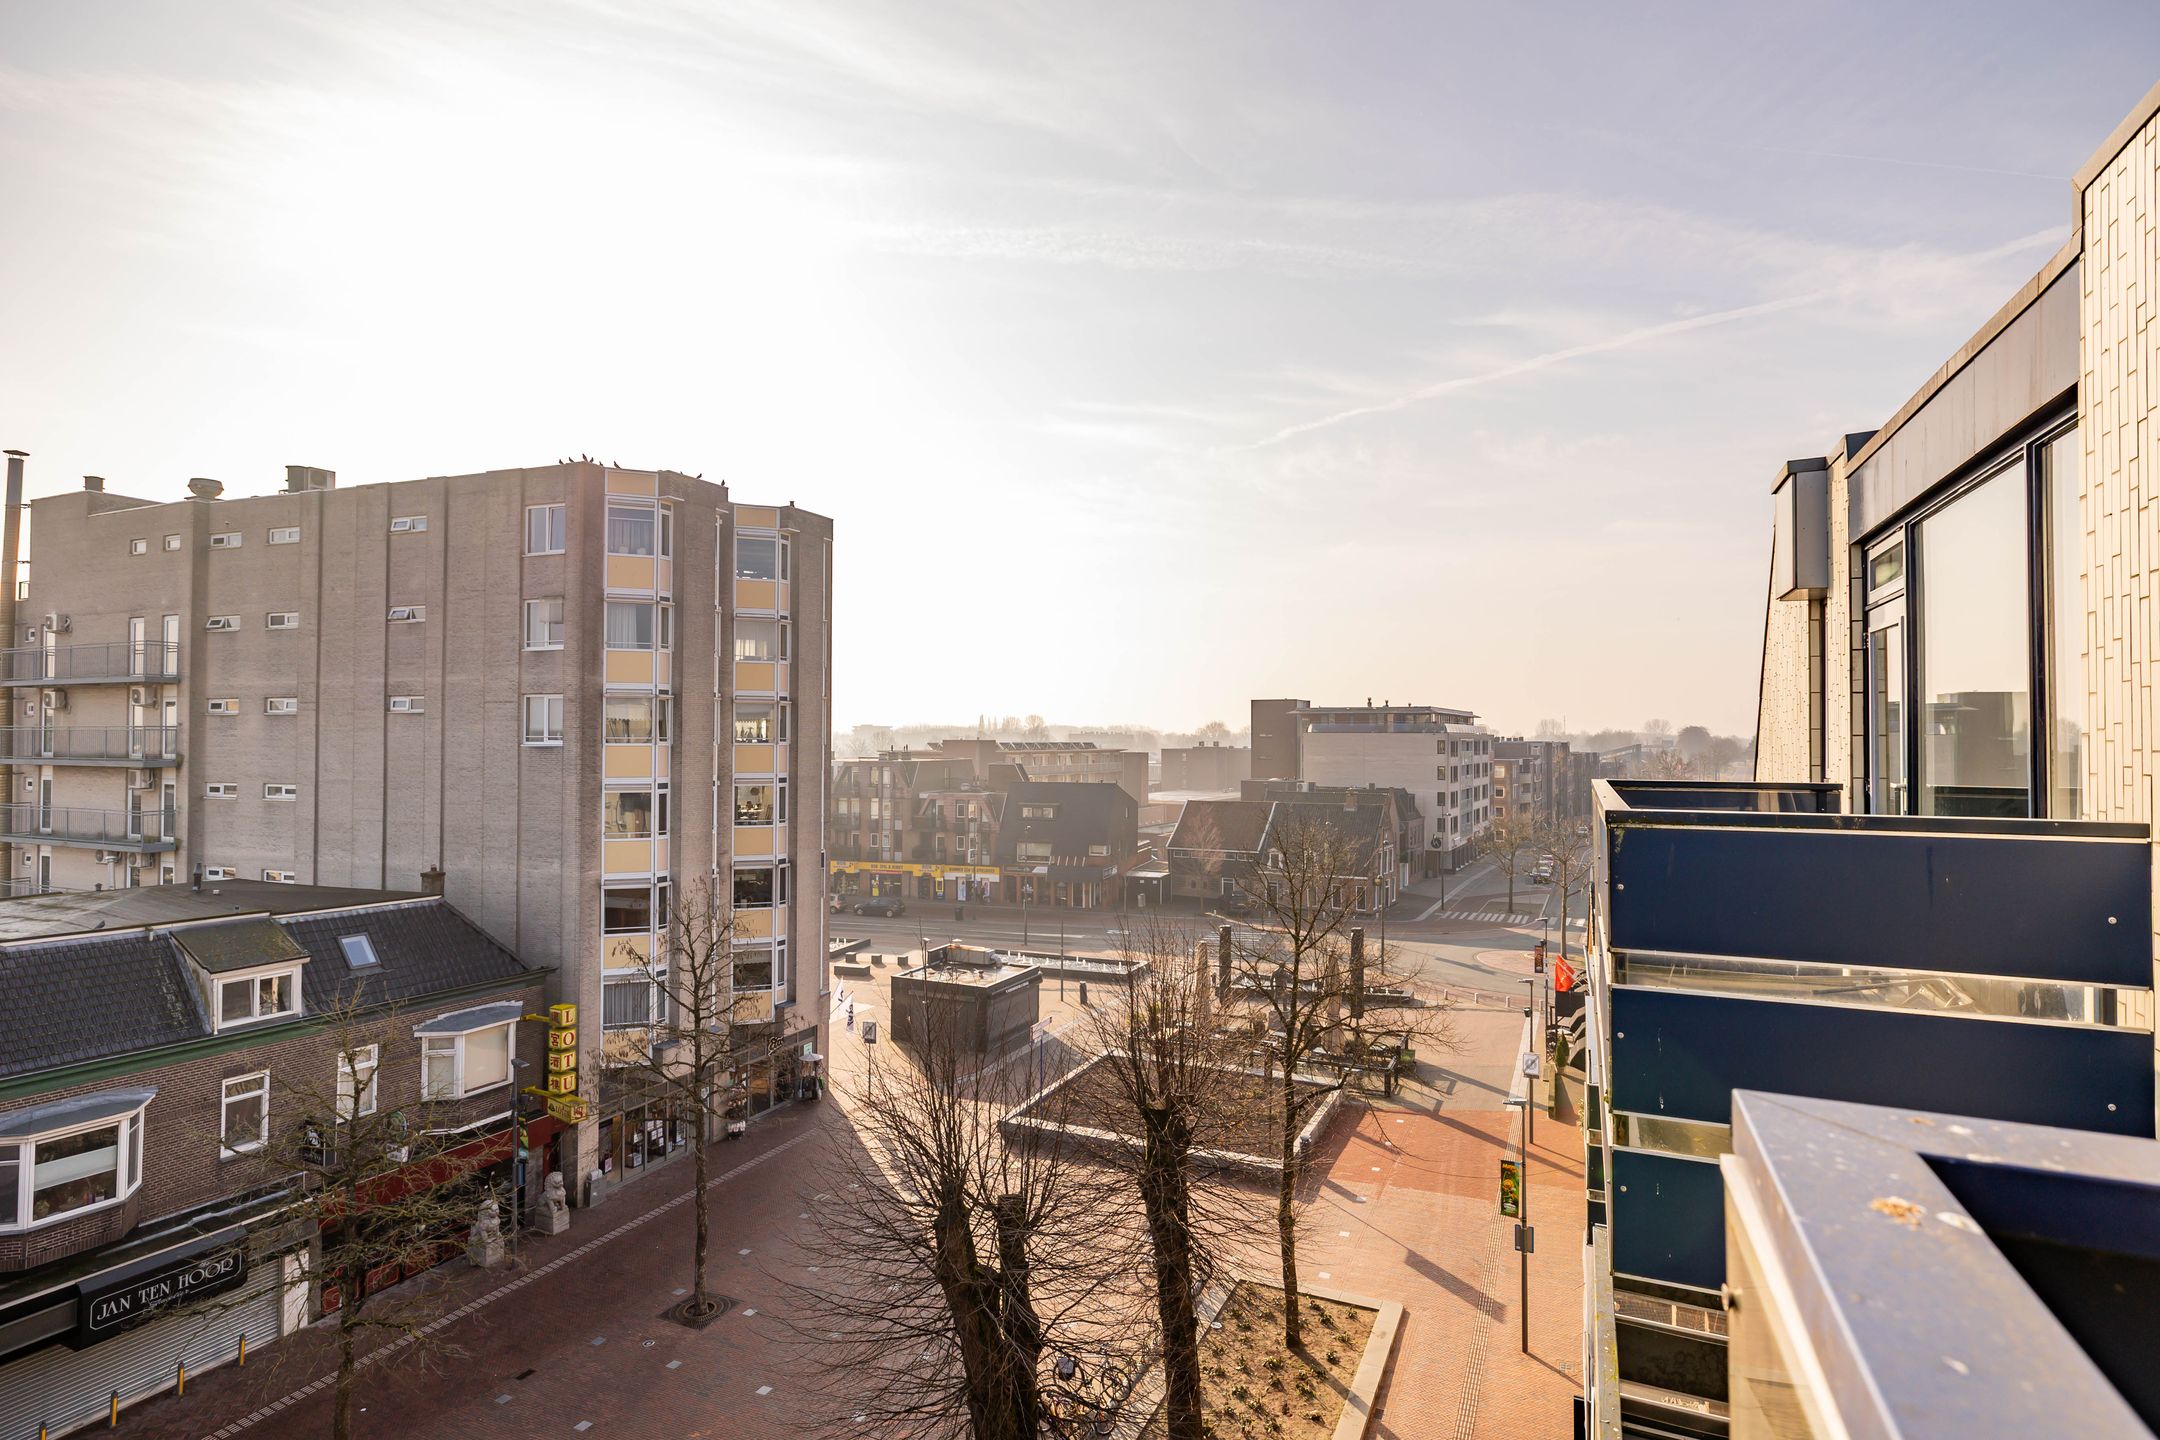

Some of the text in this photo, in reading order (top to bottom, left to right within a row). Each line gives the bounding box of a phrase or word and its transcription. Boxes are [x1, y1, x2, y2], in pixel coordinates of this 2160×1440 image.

[97, 1294, 132, 1320] JAN
[138, 1279, 171, 1305] TEN
[178, 1257, 233, 1289] HOOR
